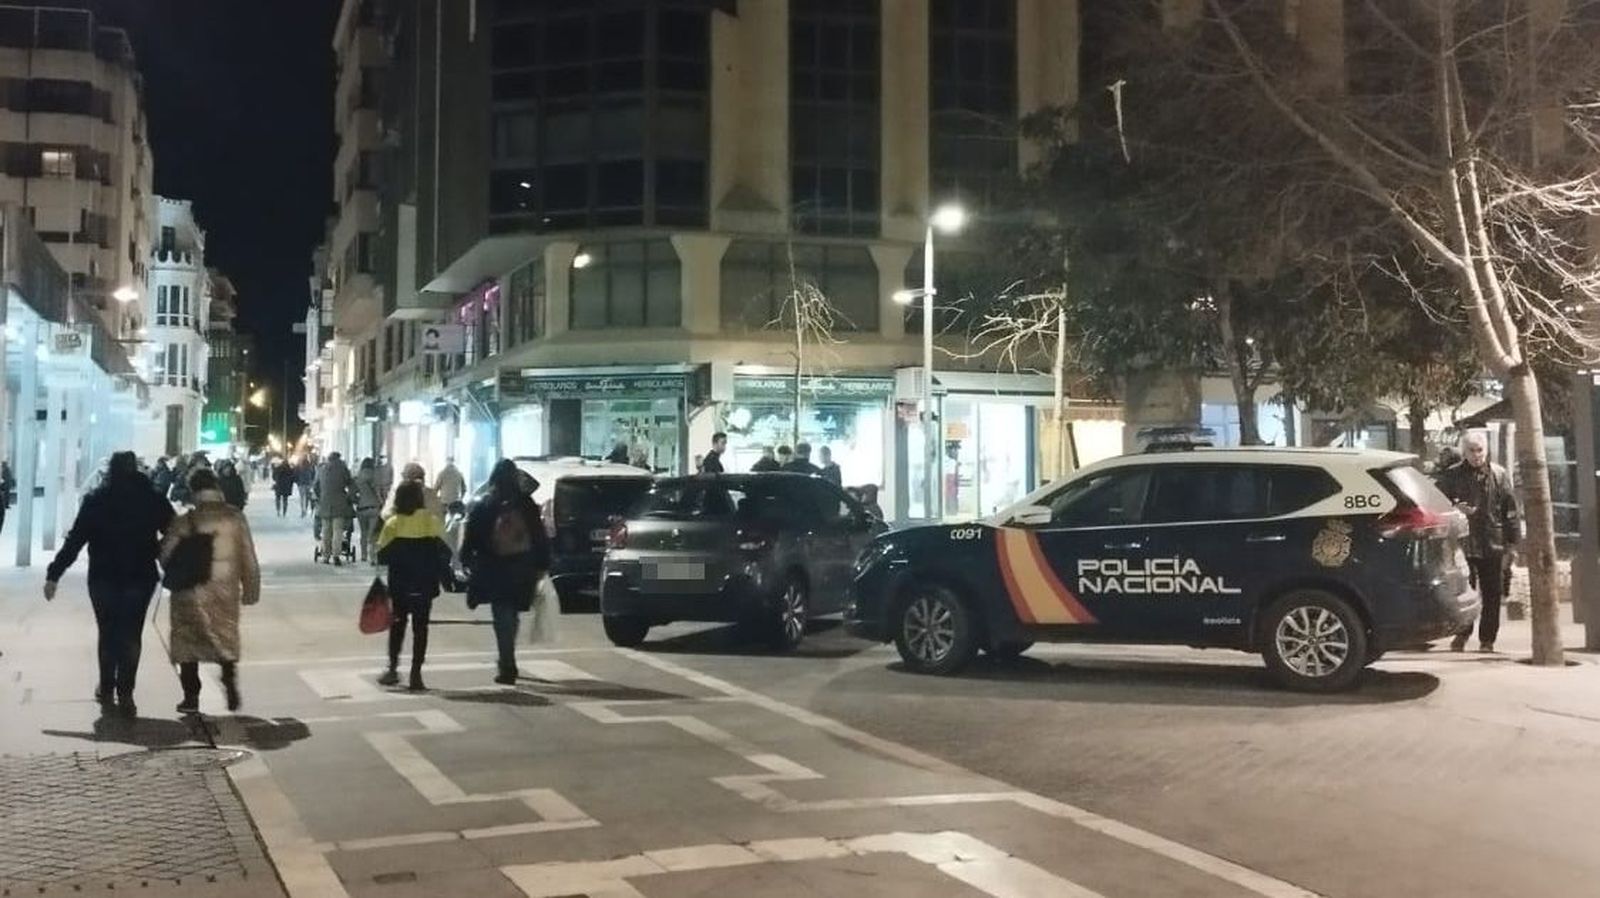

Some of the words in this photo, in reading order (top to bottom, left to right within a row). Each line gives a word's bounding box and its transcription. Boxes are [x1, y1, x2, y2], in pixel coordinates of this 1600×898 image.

[1344, 494, 1381, 509] 8BC
[1078, 555, 1201, 576] POLICÍA
[1078, 577, 1242, 594] NACIONAL
